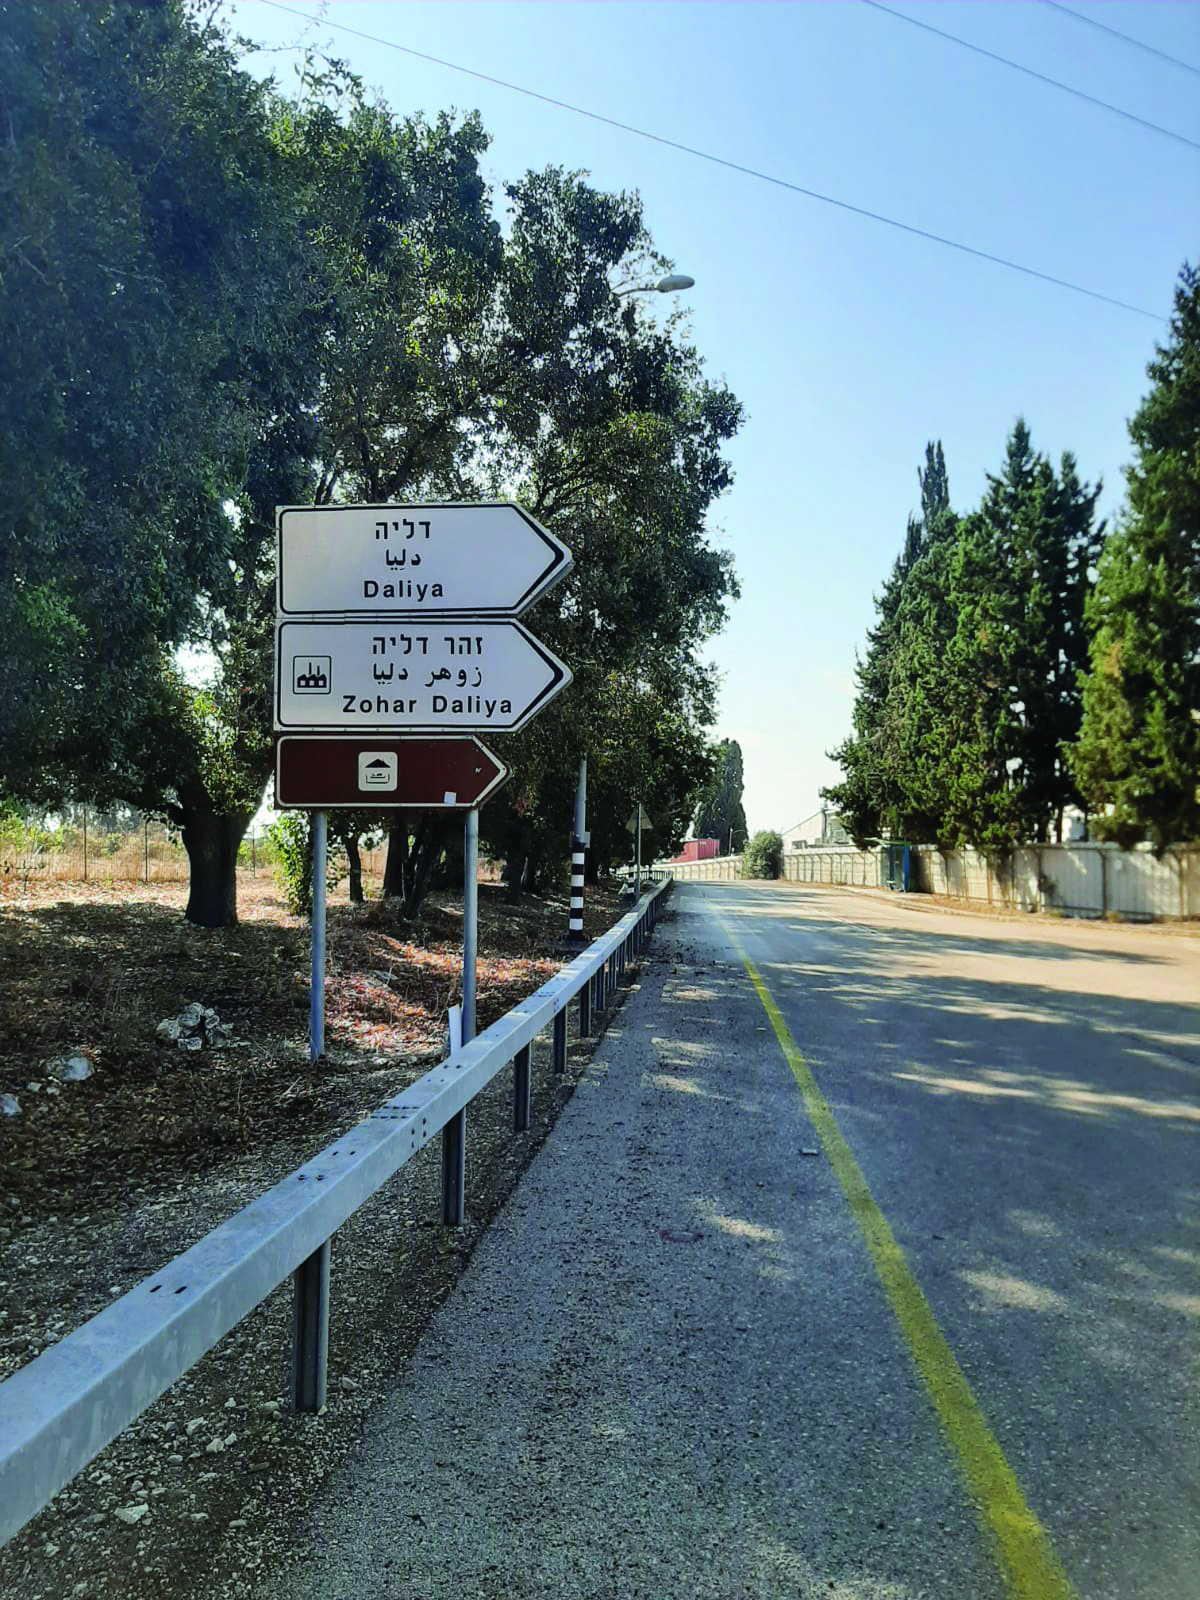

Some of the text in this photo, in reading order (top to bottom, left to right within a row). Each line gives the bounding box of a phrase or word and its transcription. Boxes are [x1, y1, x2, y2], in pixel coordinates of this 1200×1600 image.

[375, 518, 431, 540] דליה
[363, 579, 444, 603] Daliya
[372, 633, 483, 655] זהר דליה
[424, 666, 482, 688] زوهر
[342, 694, 512, 718] Zohar Daliya
